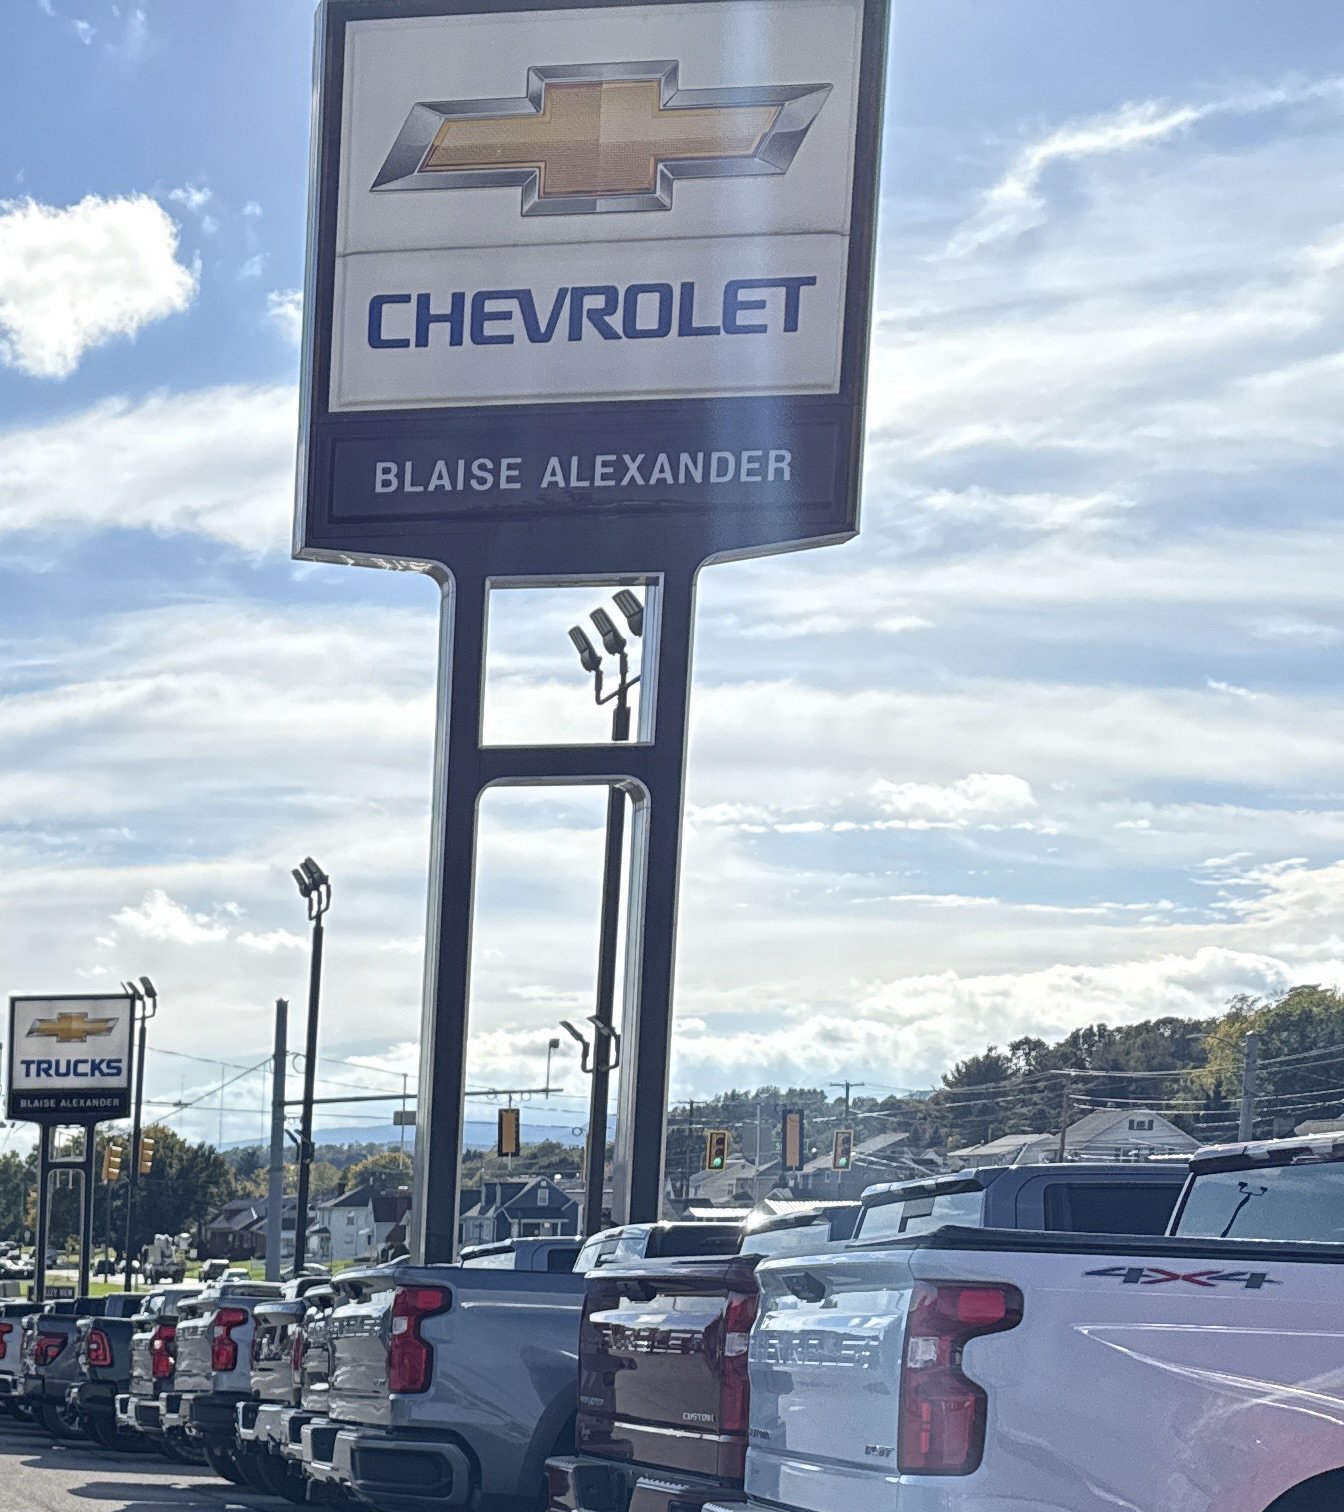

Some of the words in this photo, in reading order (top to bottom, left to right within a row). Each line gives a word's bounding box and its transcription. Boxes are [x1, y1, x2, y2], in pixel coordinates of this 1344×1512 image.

[368, 276, 817, 349] CHEVROLET
[374, 457, 522, 494] BLAISE
[540, 449, 792, 489] ALEXANDER
[20, 1058, 123, 1078] TRUCKS
[19, 1098, 56, 1108] BLAISE
[60, 1097, 120, 1108] ALEXANDER
